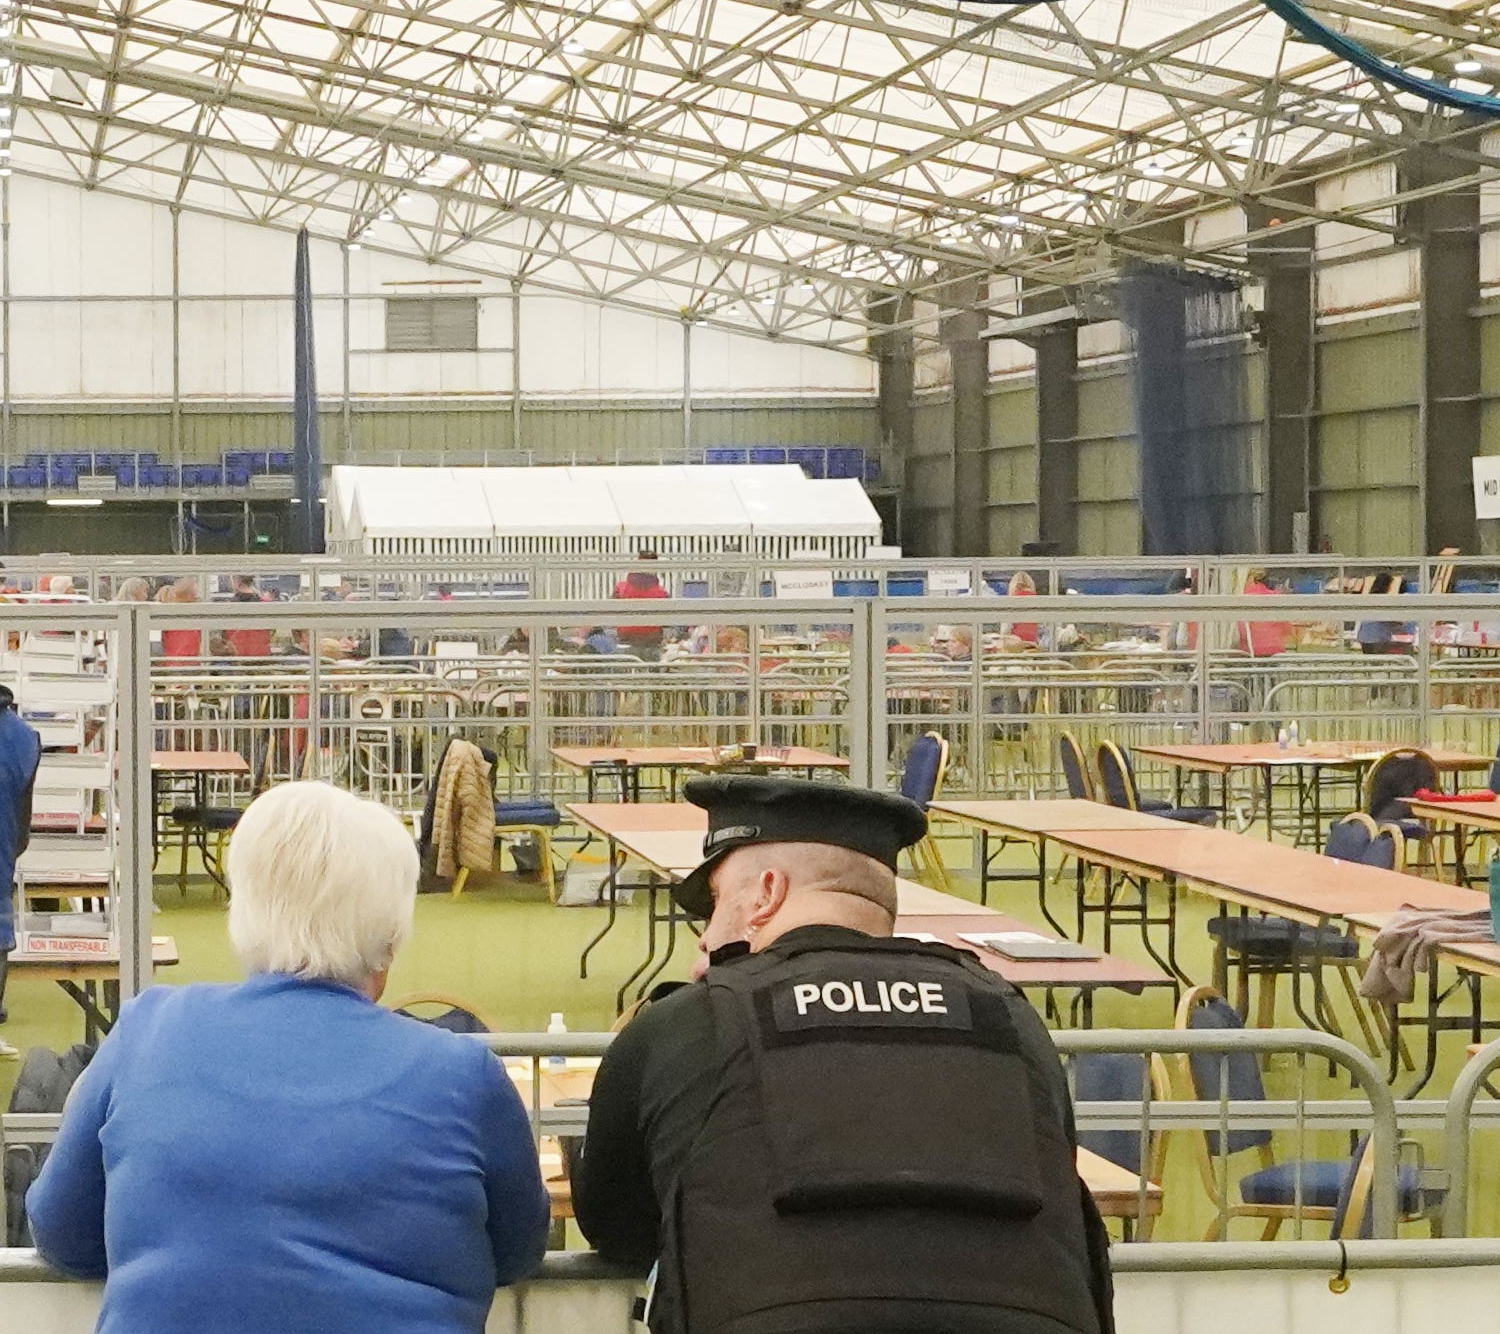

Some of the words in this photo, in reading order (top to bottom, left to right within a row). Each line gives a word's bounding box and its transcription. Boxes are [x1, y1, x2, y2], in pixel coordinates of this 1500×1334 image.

[1483, 478, 1498, 496] MID
[30, 940, 47, 950] NON
[49, 940, 109, 953] TRANSFERABLE
[792, 980, 948, 1016] POLICE
